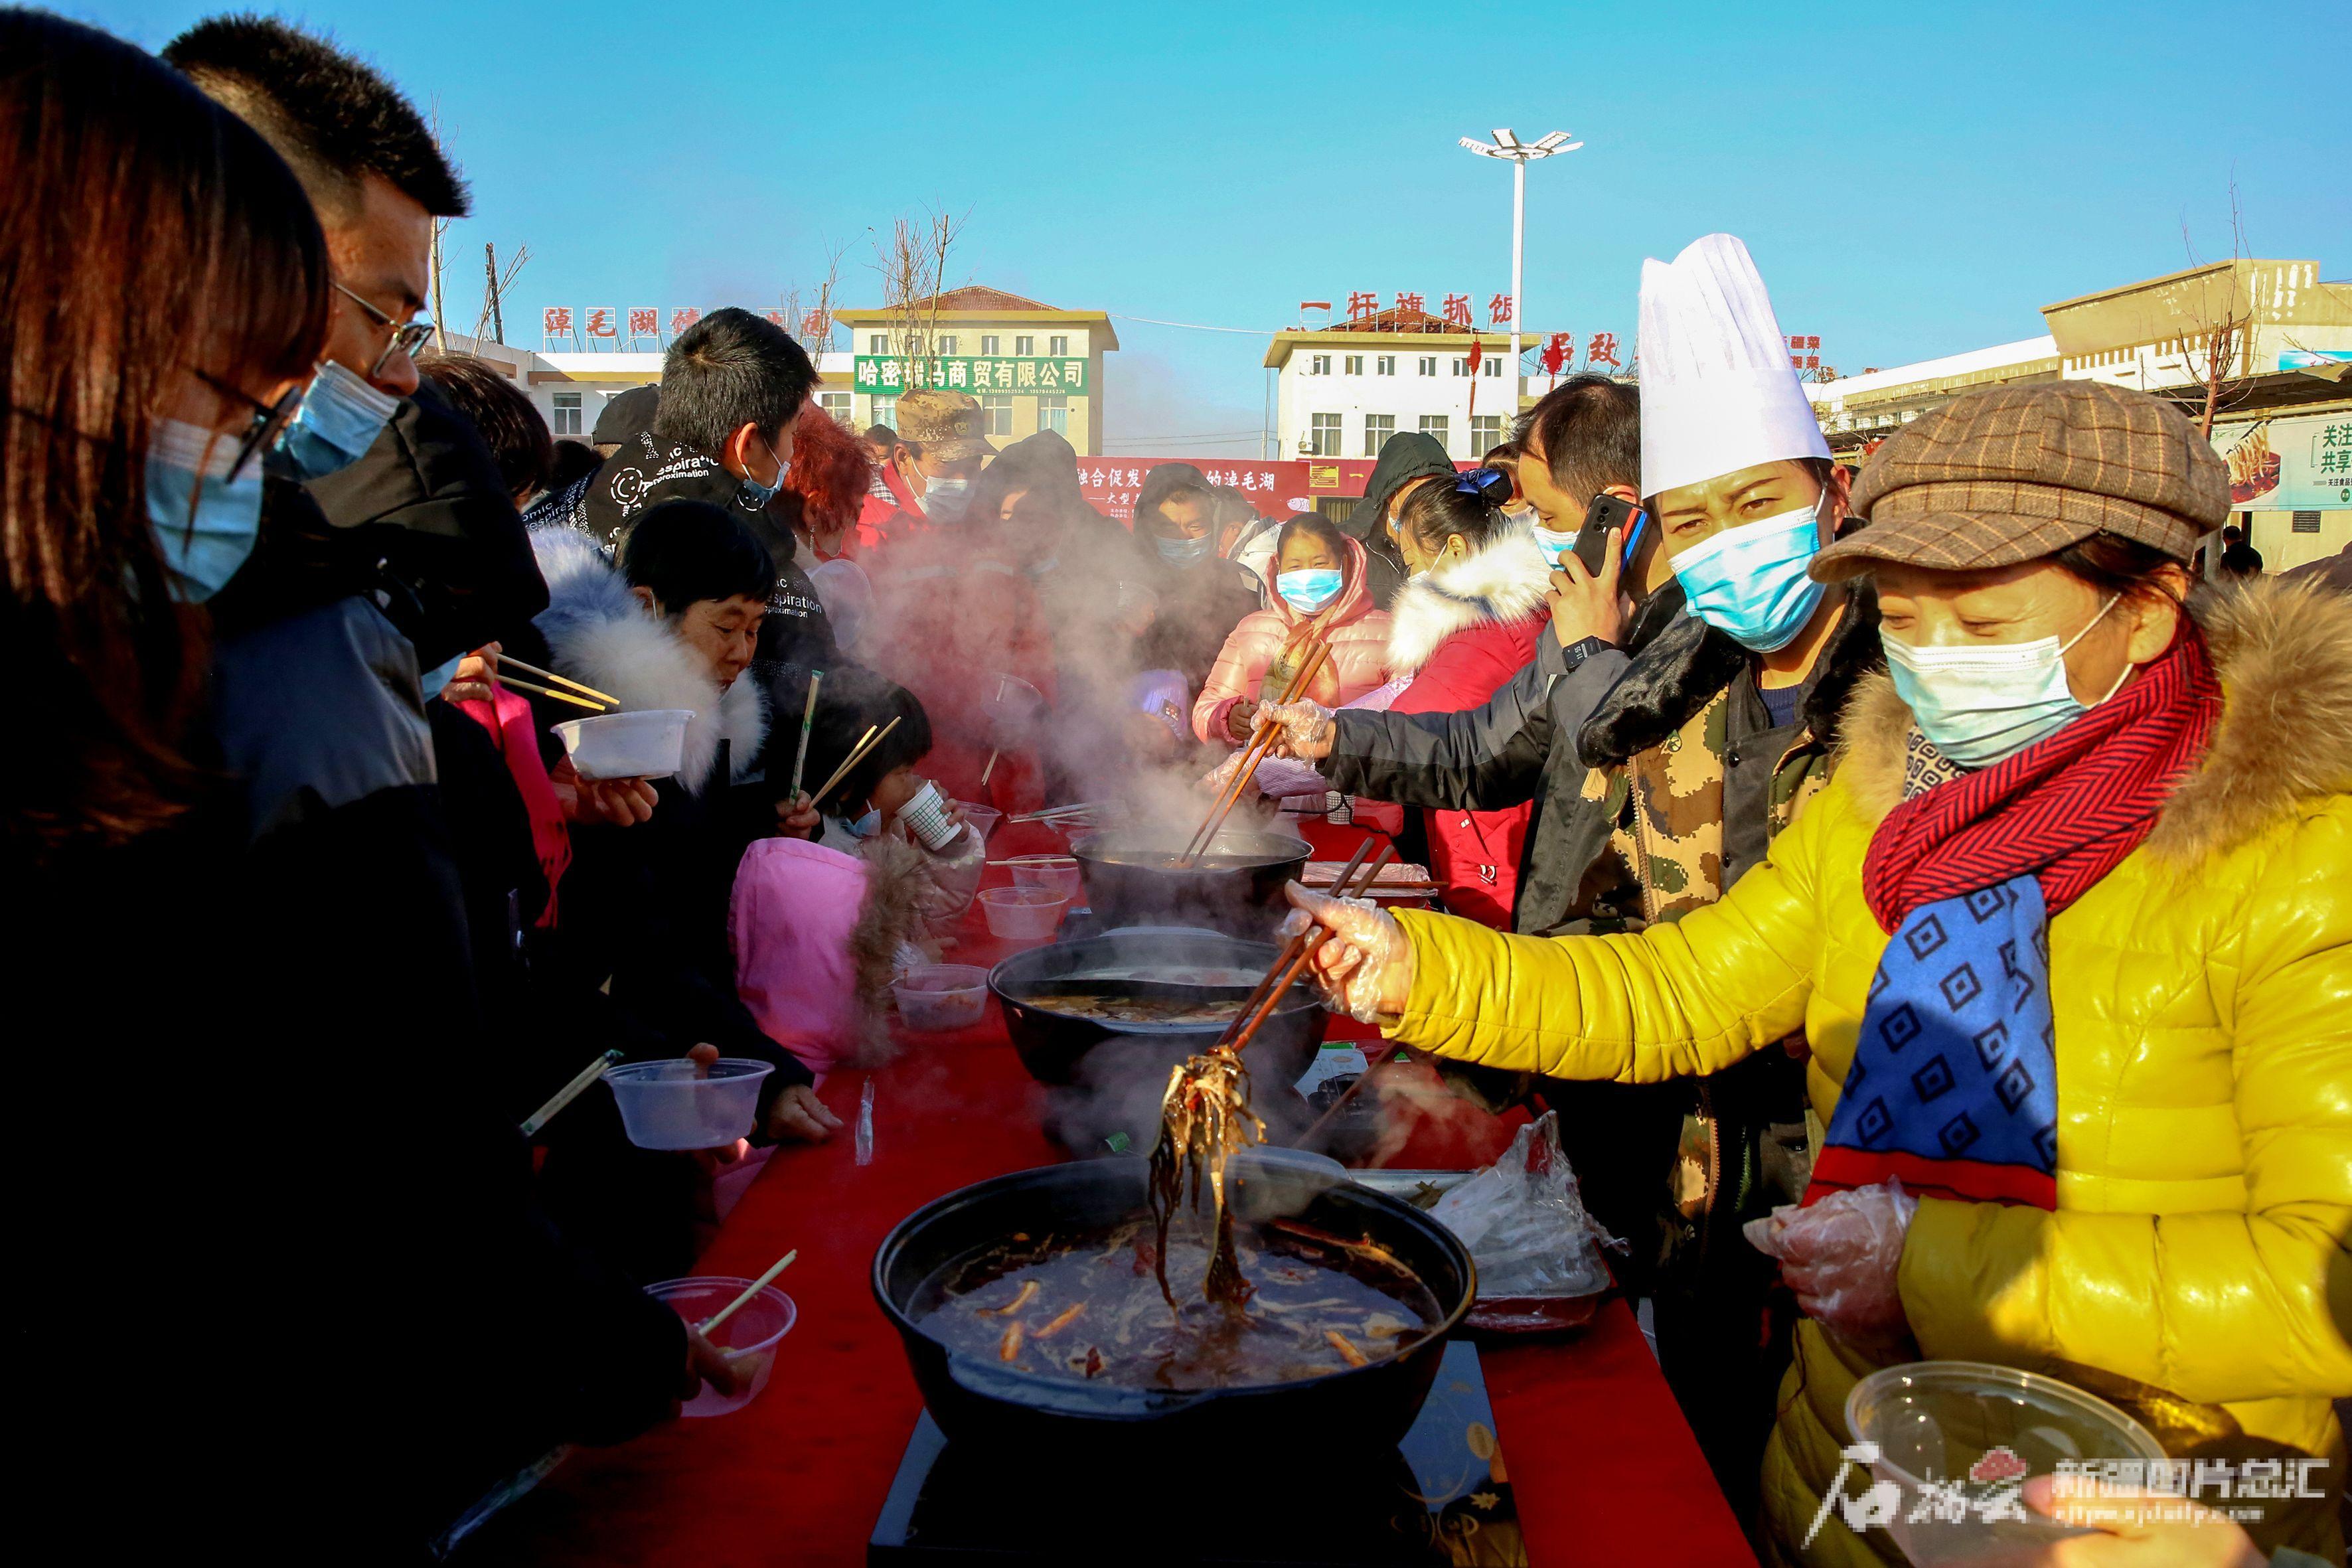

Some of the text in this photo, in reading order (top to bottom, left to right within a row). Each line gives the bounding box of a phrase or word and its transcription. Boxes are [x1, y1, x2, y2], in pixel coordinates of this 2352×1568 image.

[1300, 291, 1512, 325] 一杆旗抓饭
[1784, 336, 1820, 349] 疆菜
[858, 359, 1083, 388] 哈密瑞马商贸有限公司
[1077, 467, 1150, 488] 融合促发
